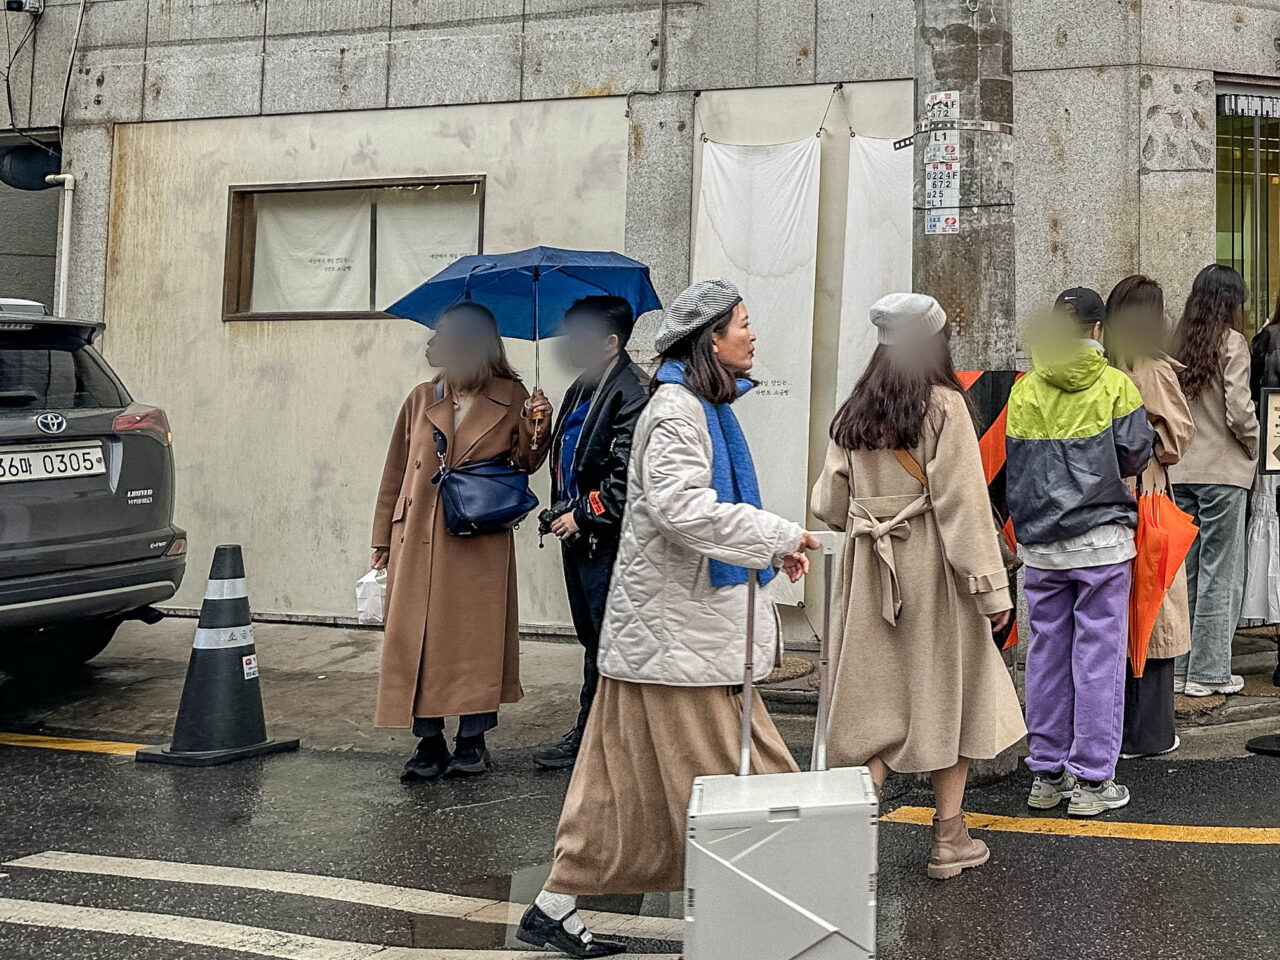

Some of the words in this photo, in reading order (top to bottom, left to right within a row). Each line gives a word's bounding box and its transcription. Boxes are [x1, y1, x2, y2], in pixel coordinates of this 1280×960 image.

[932, 180, 951, 189] 672
[42, 451, 94, 474] 0305
[228, 628, 254, 642] 소금
